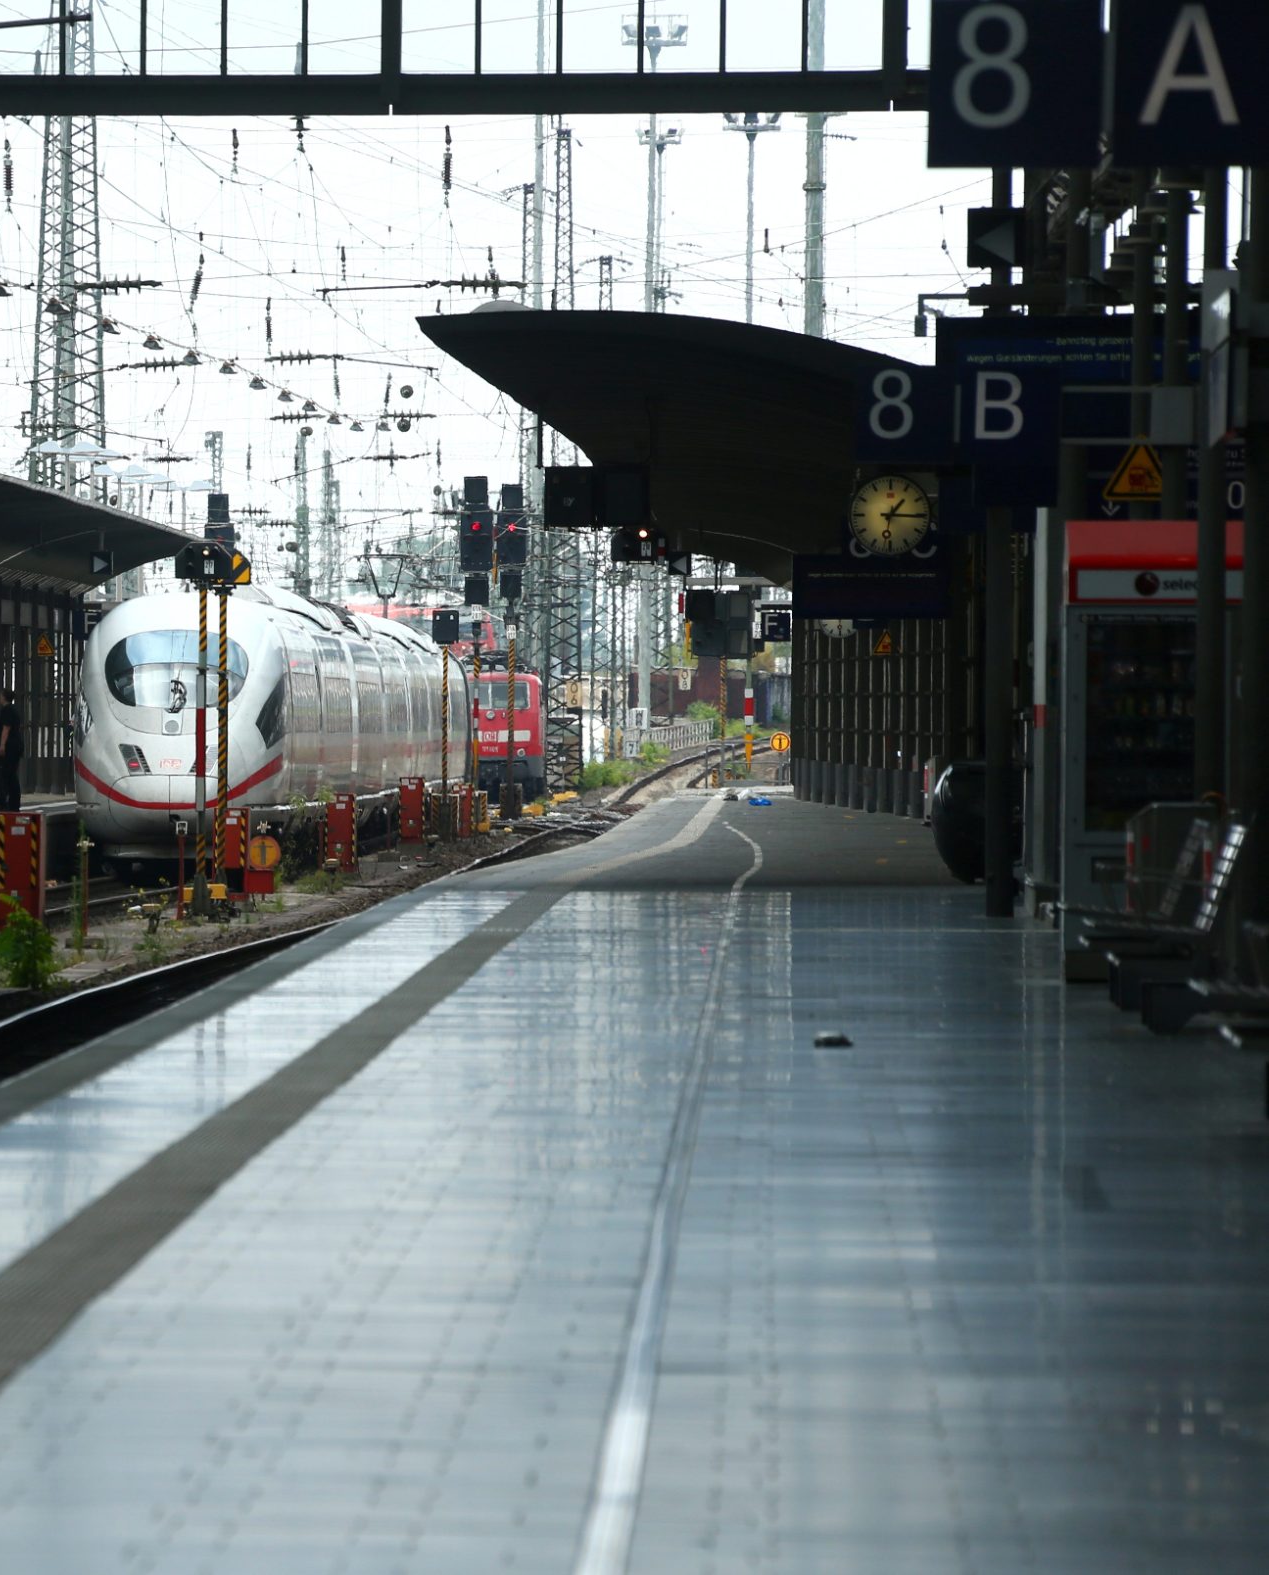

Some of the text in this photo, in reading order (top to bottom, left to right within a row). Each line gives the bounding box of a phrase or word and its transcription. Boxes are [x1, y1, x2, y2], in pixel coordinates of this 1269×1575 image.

[952, 3, 1240, 129] 8 A
[869, 369, 1024, 440] 8 B
[1162, 578, 1200, 591] selec
[84, 612, 98, 634] F
[765, 613, 778, 636] F
